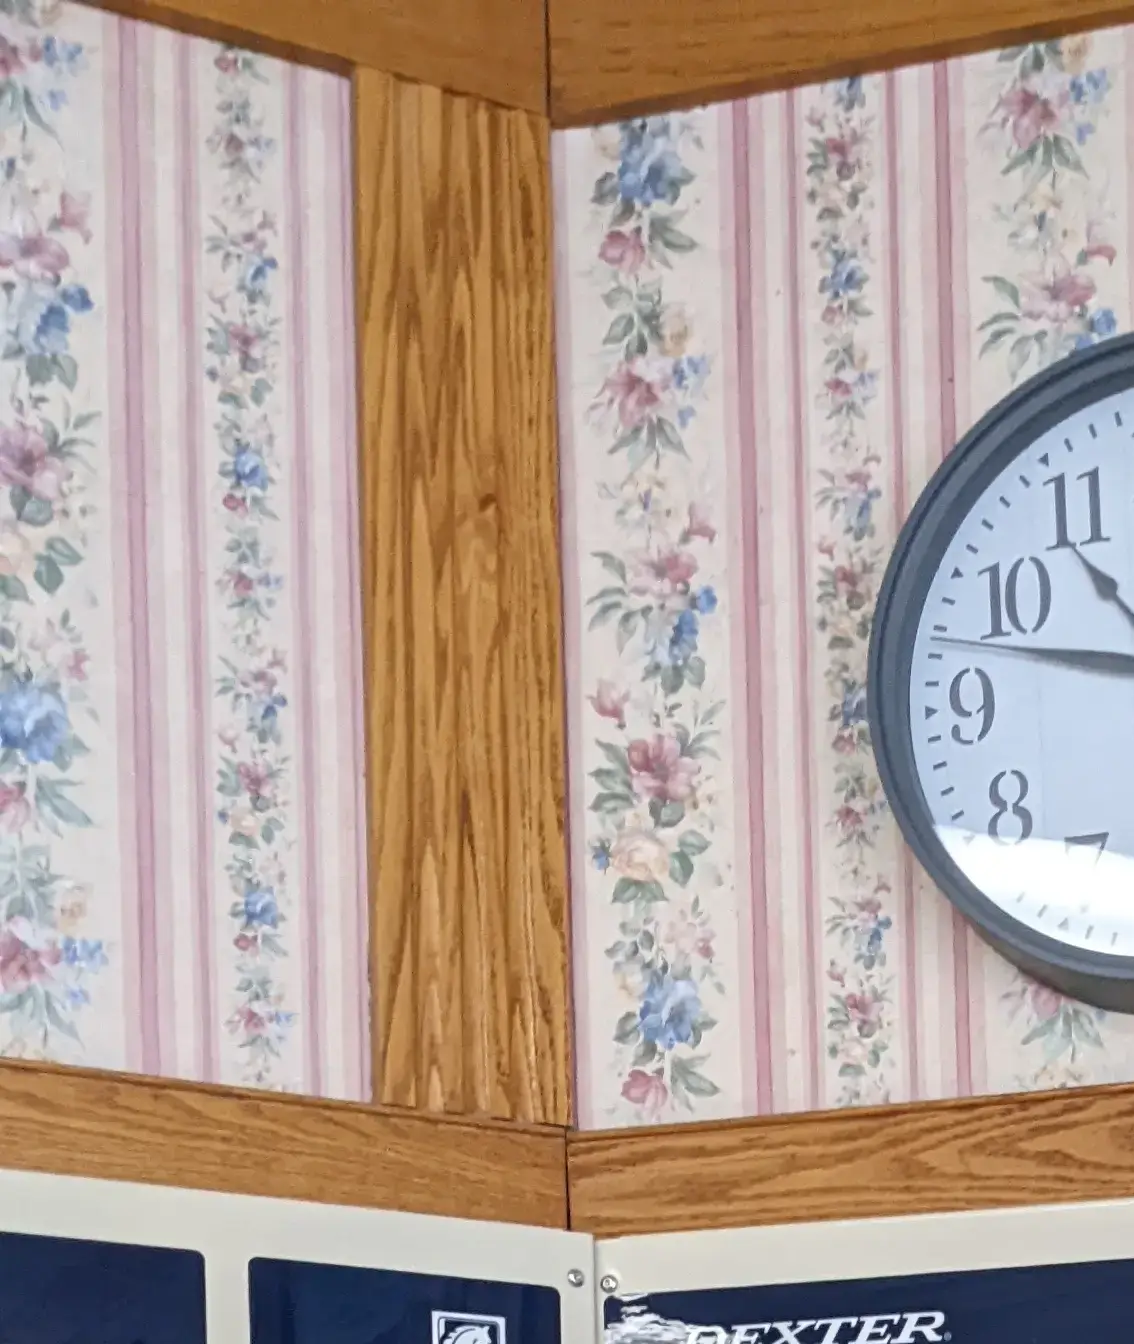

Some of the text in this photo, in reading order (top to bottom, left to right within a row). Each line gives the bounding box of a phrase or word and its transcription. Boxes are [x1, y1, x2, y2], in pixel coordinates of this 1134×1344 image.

[1043, 466, 1111, 551] 11
[976, 556, 1052, 641] 10
[948, 667, 996, 745] 9
[987, 769, 1034, 847] 8
